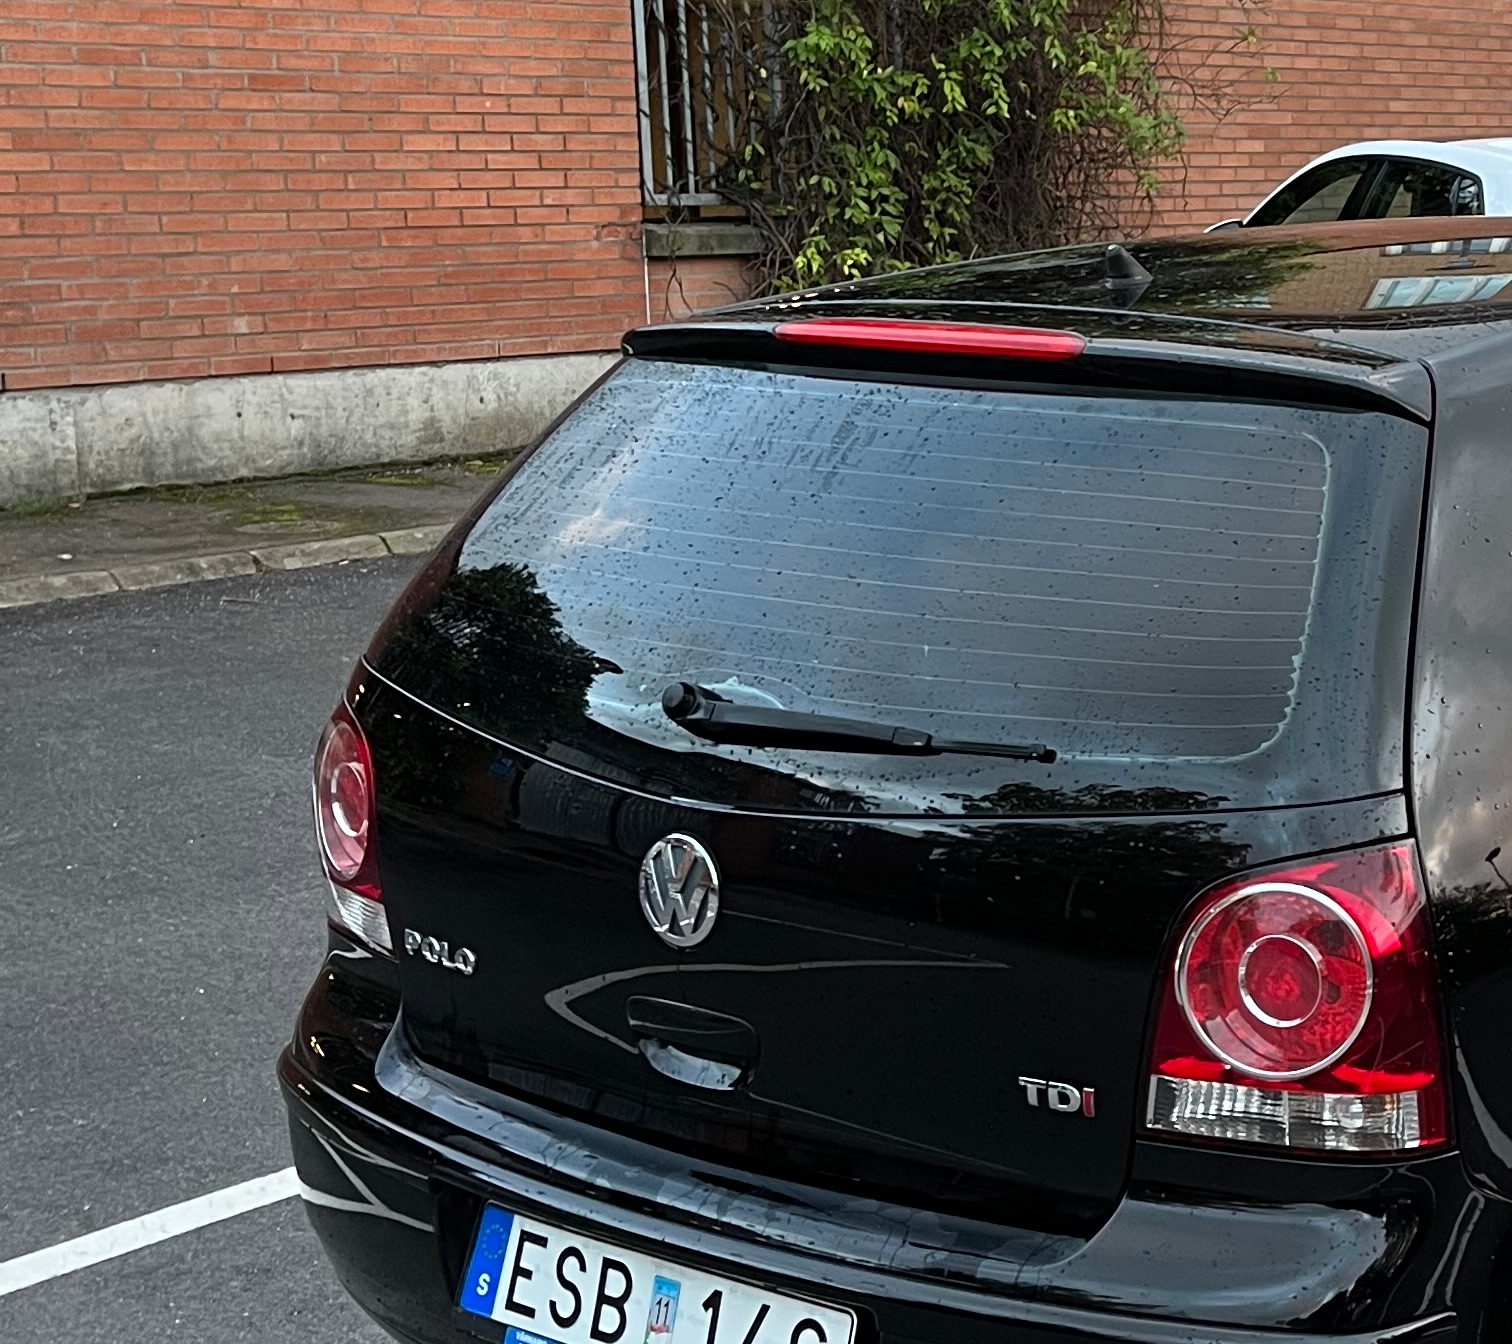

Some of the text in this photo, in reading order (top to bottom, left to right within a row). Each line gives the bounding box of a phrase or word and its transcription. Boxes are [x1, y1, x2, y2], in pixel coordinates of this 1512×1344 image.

[404, 928, 478, 976] POLO
[1018, 1076, 1095, 1118] TDI
[476, 1272, 490, 1296] S
[504, 1228, 633, 1344] ESB
